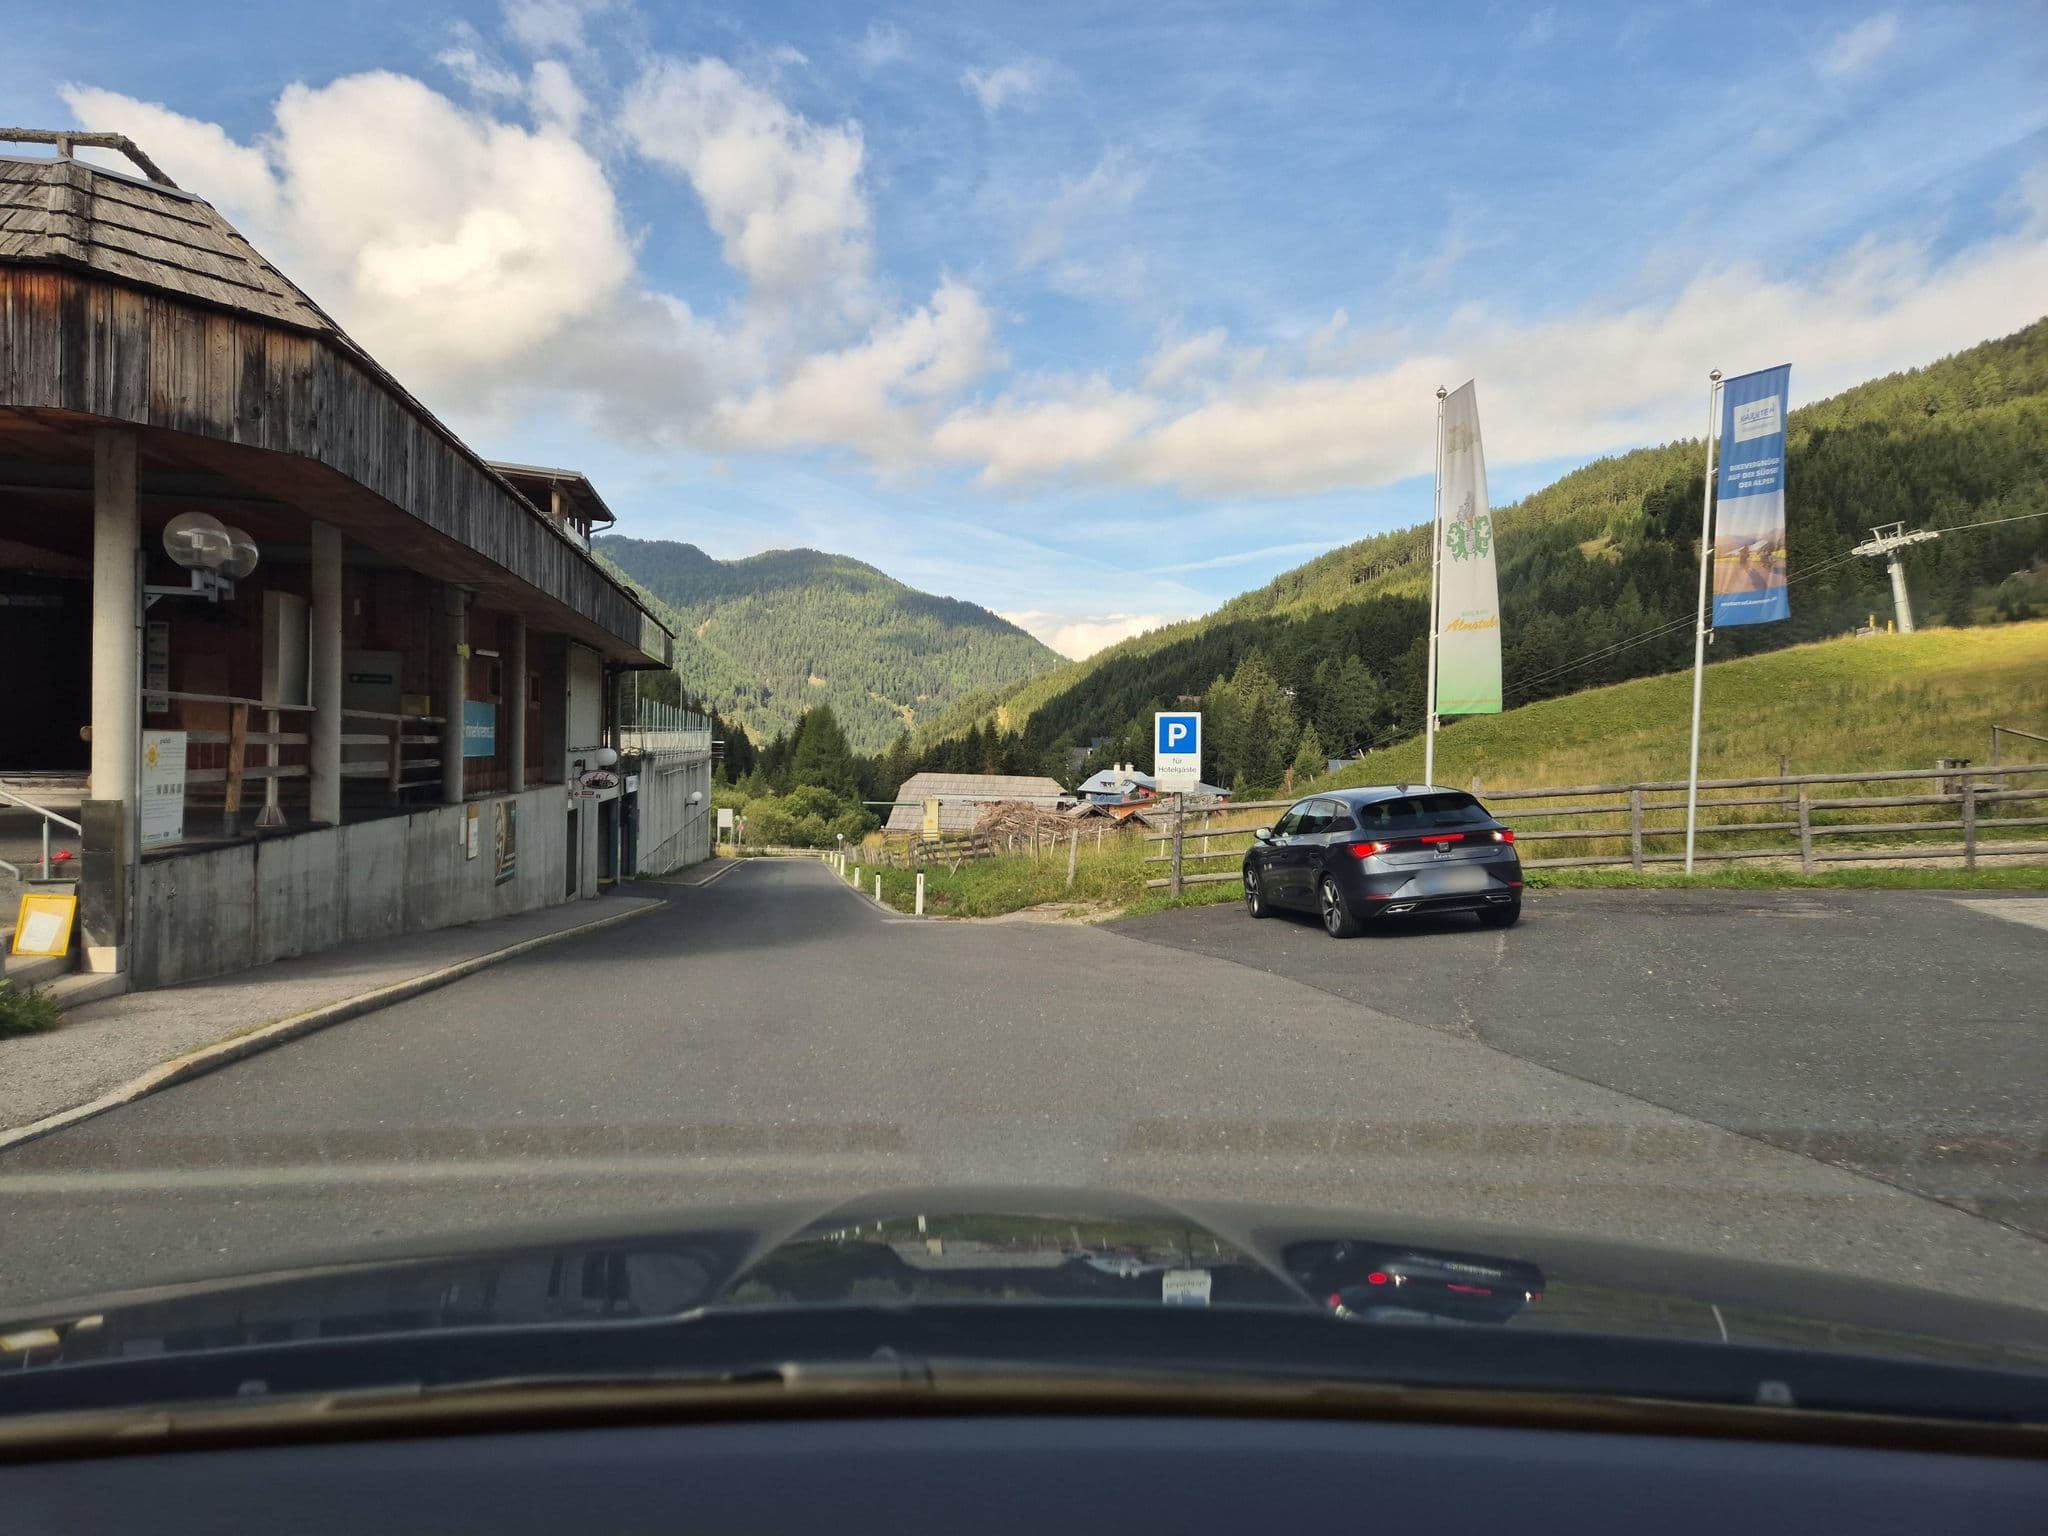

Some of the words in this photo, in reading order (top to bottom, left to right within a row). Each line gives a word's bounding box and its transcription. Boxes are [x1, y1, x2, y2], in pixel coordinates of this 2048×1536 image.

[1742, 471, 1756, 479] DER
[1753, 477, 1775, 486] ALPEN
[1168, 723, 1187, 747] P
[1159, 766, 1197, 774] Hotelgäste
